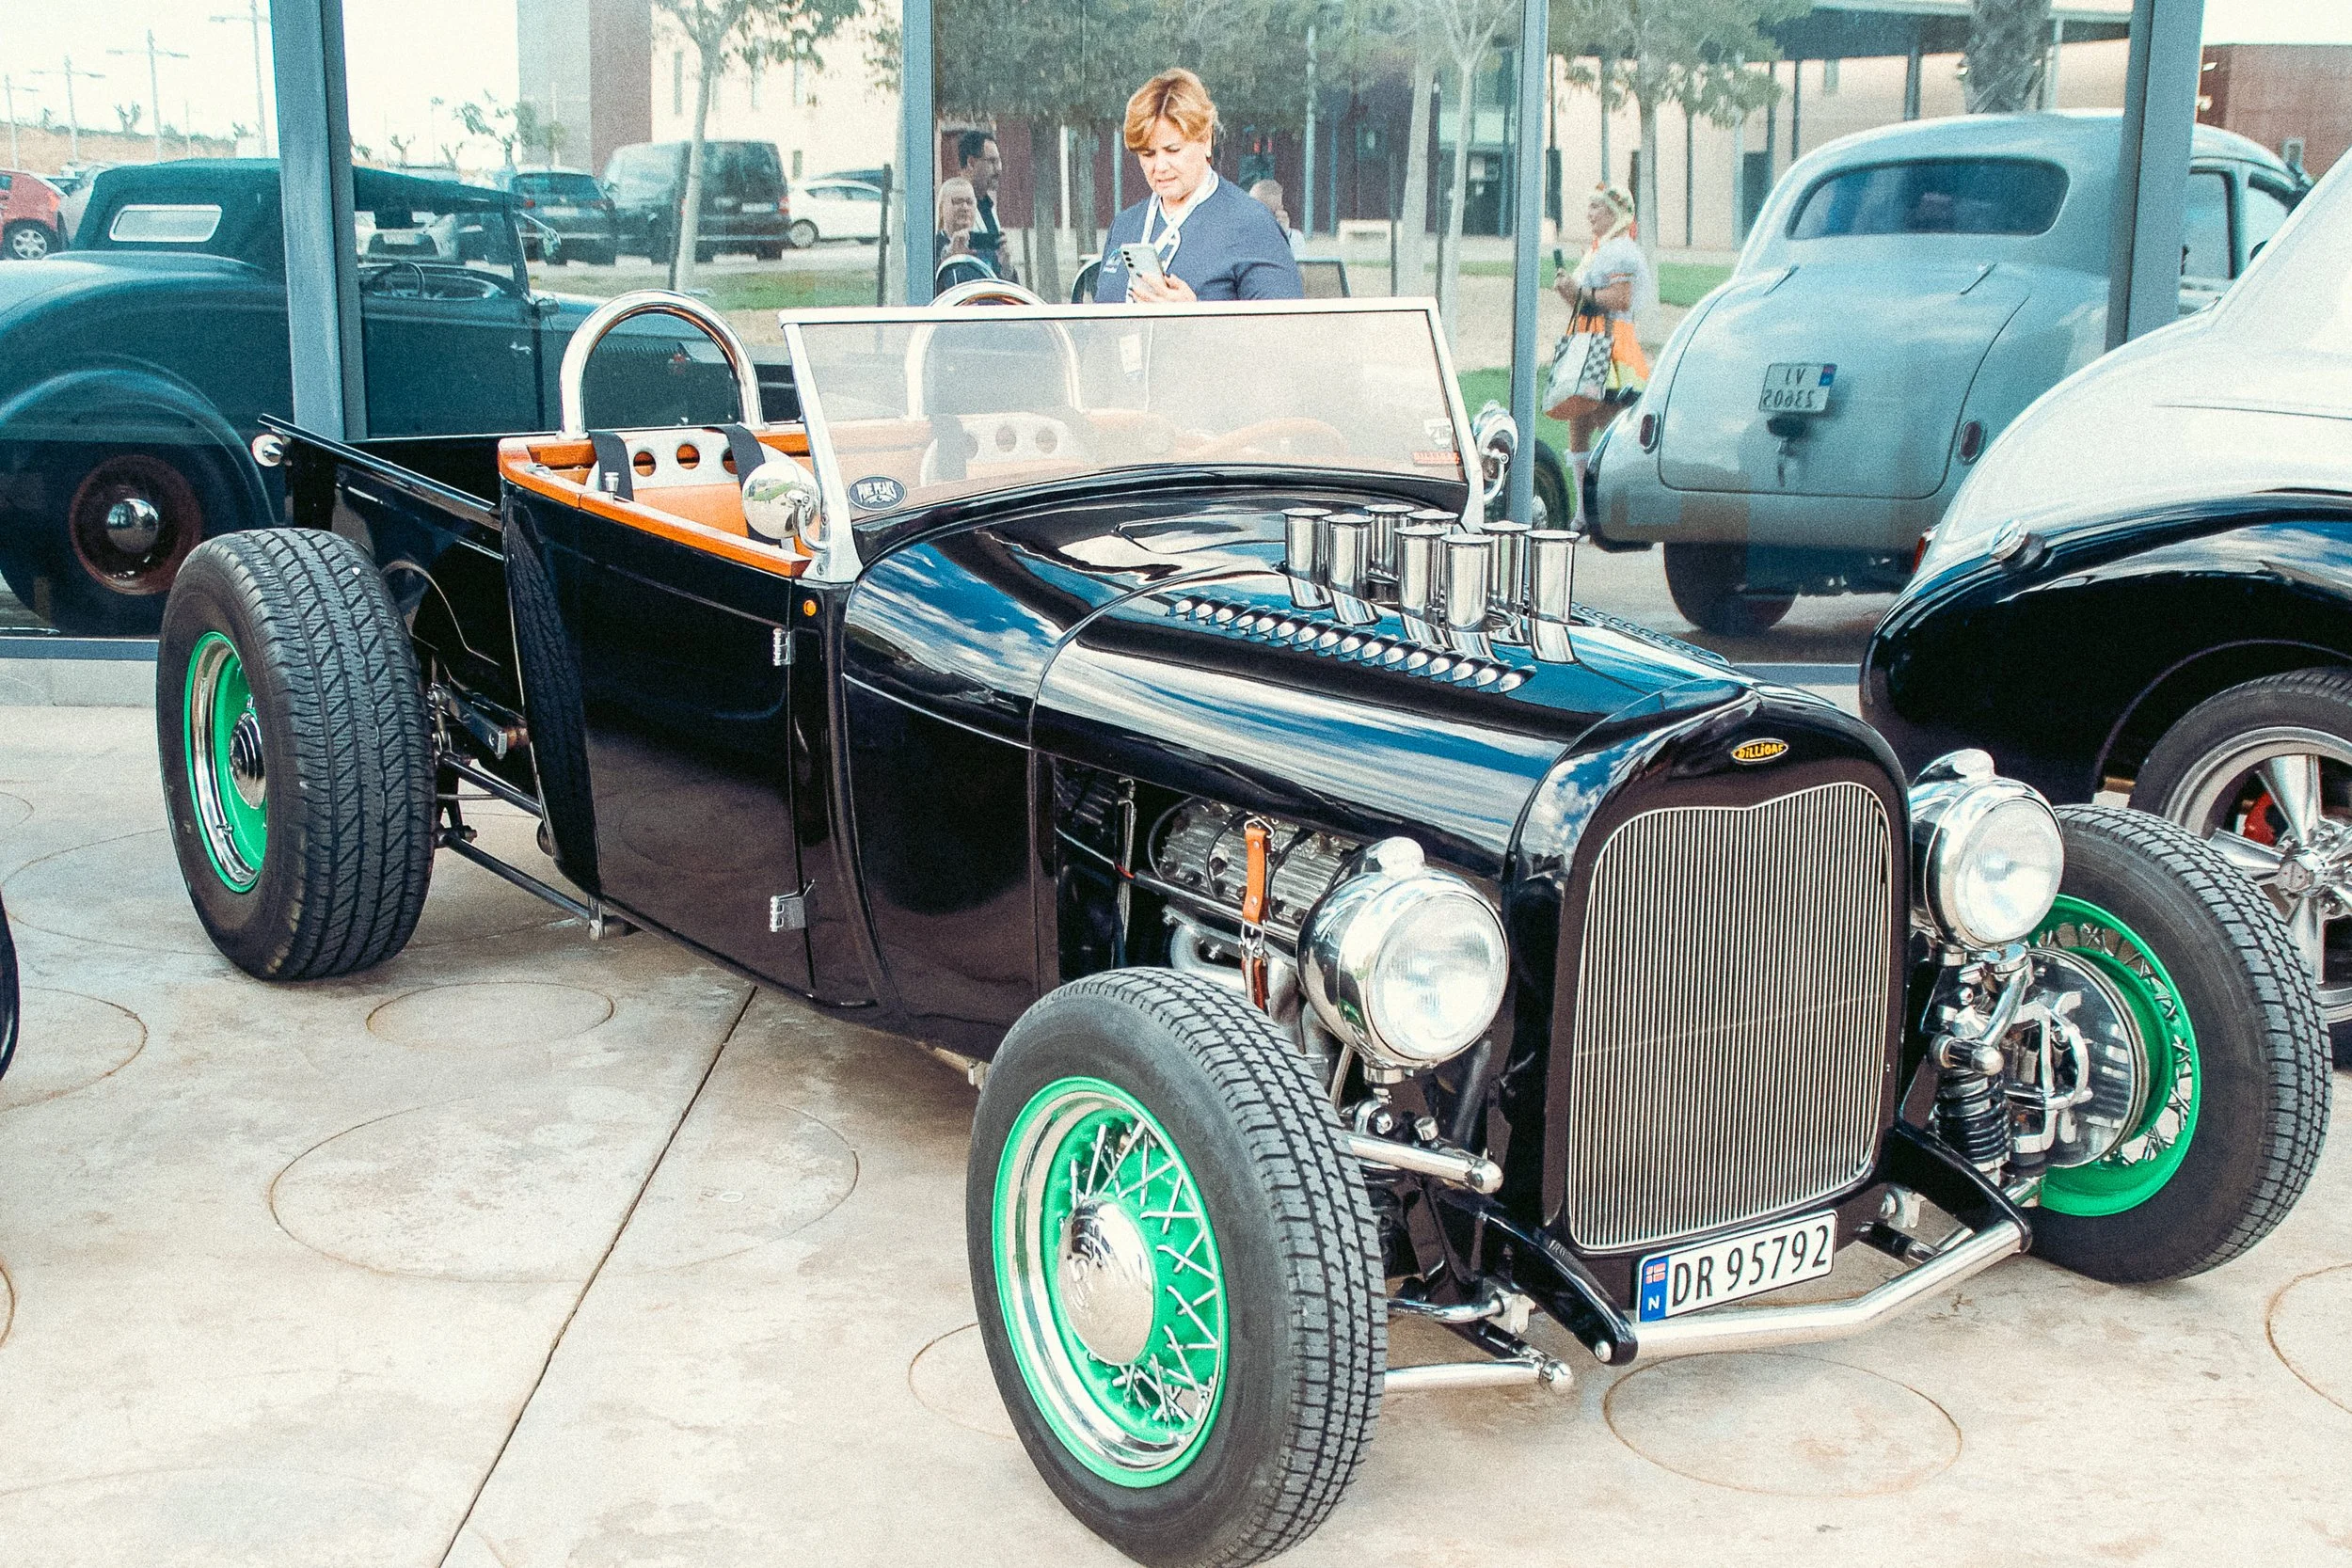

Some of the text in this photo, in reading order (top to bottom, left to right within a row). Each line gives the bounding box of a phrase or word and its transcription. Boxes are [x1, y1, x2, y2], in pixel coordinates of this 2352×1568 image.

[1672, 1225, 1829, 1307] DR 95792
[1647, 1295, 1661, 1311] N
